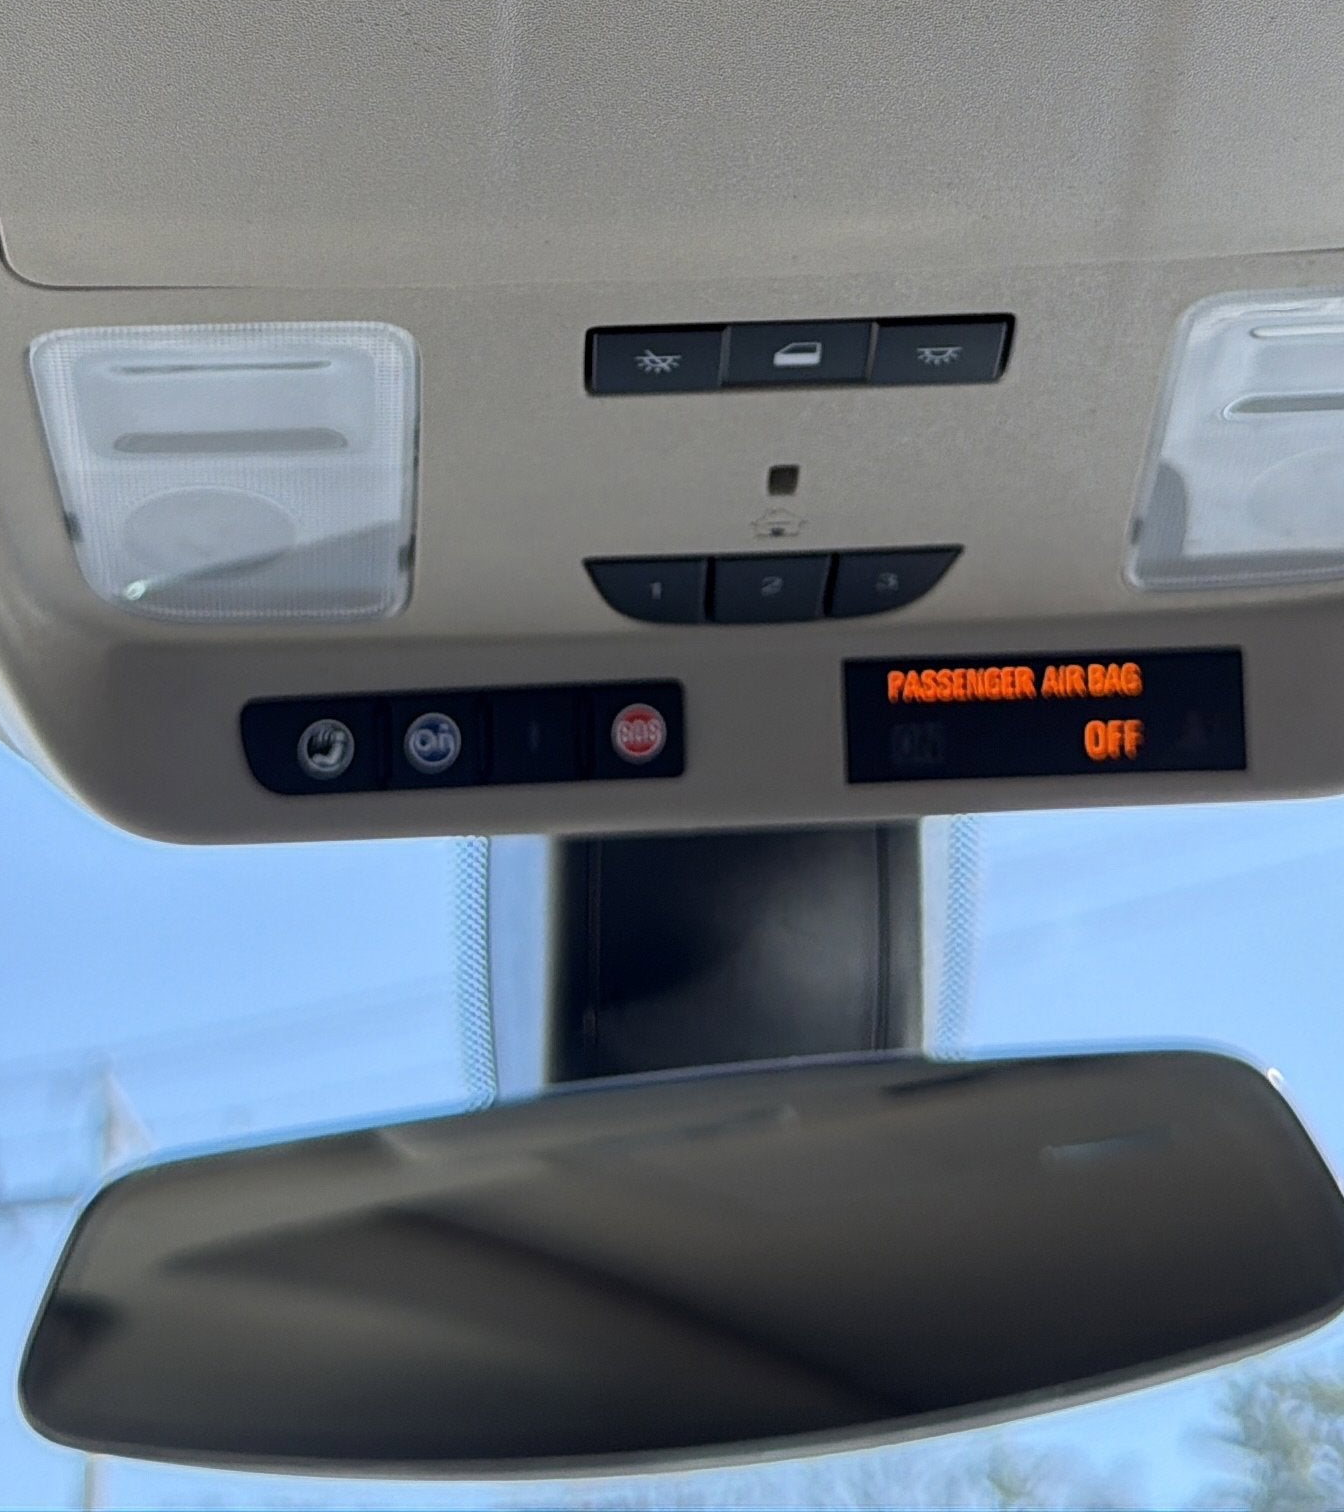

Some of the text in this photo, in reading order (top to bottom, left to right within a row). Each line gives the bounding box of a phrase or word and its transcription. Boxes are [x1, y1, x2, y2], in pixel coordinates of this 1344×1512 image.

[650, 582, 662, 600] 1
[761, 576, 784, 596] 2
[876, 572, 899, 592] 3
[887, 666, 1037, 704] PASSENGER
[1042, 664, 1087, 700] AIR
[1084, 720, 1145, 761] OFF
